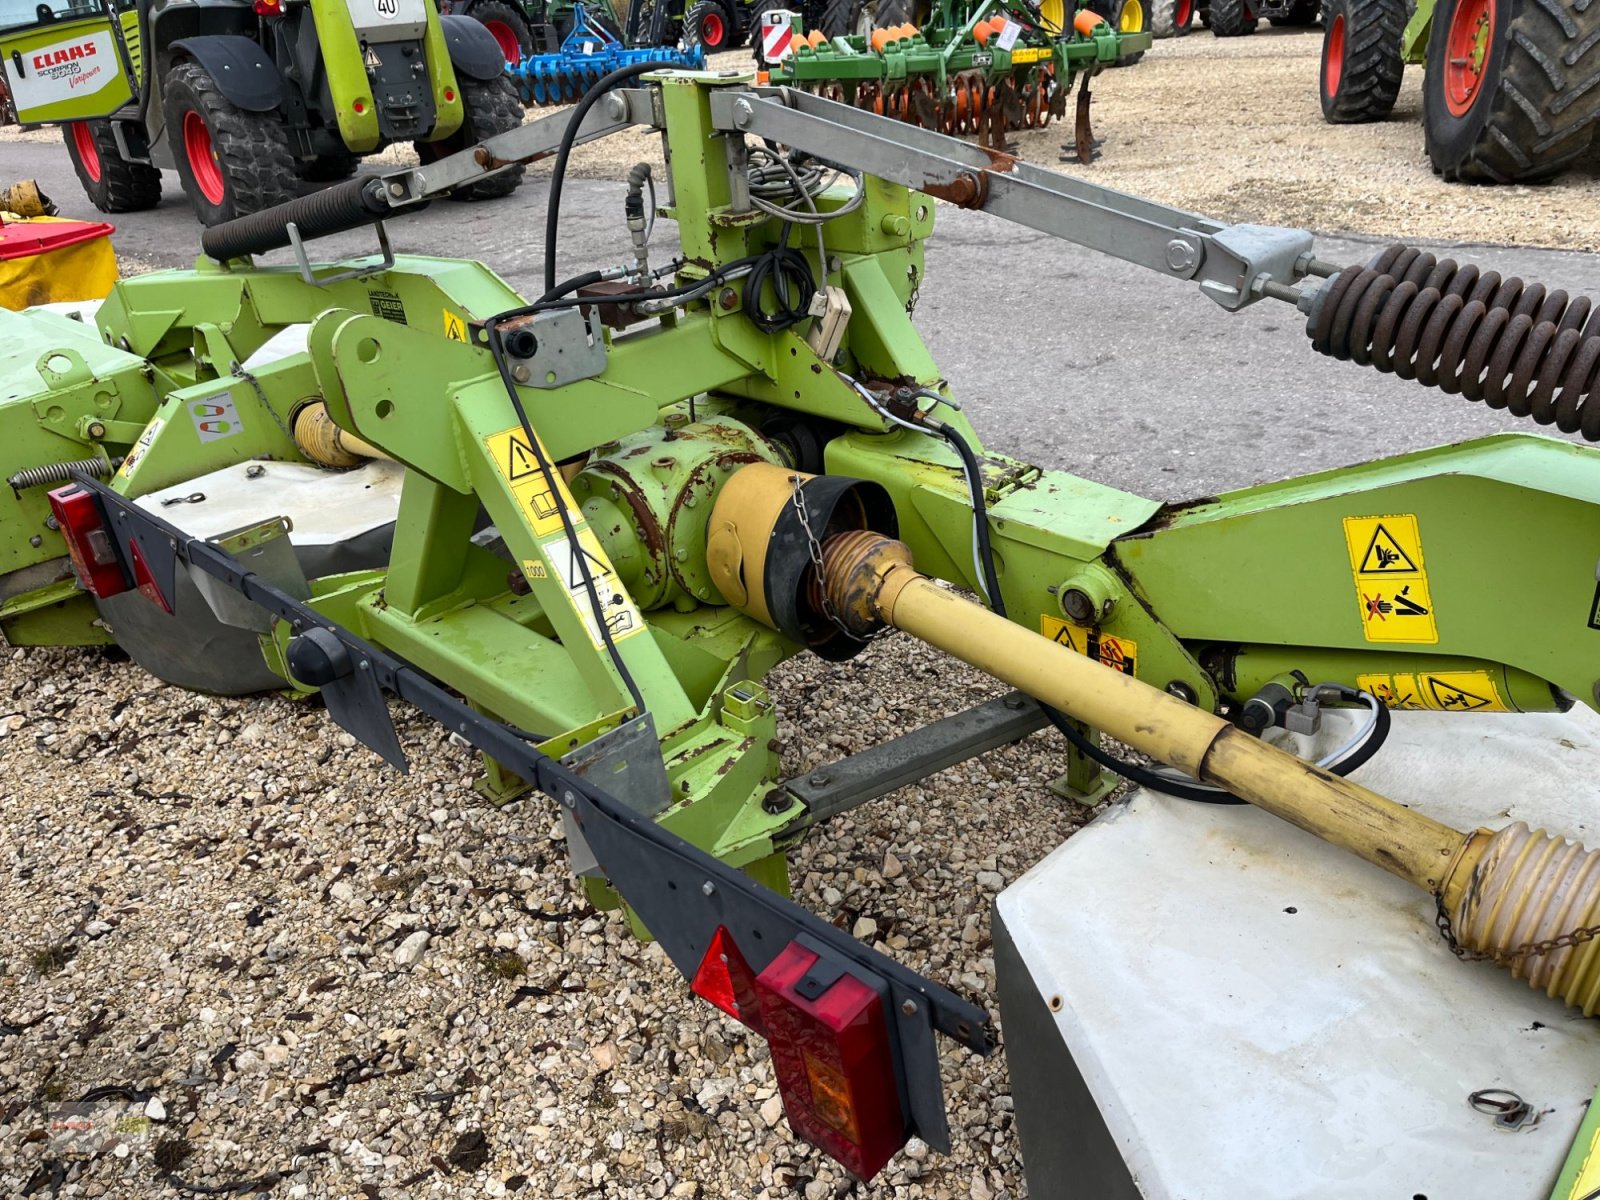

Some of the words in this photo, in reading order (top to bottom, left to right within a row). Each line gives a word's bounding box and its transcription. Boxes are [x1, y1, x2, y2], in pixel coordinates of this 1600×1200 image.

[378, 0, 395, 14] 40
[33, 42, 97, 70] CLAAS
[37, 61, 79, 77] SCORPION
[50, 66, 81, 80] 9040
[380, 300, 402, 311] GEIER
[526, 565, 545, 577] 1000
